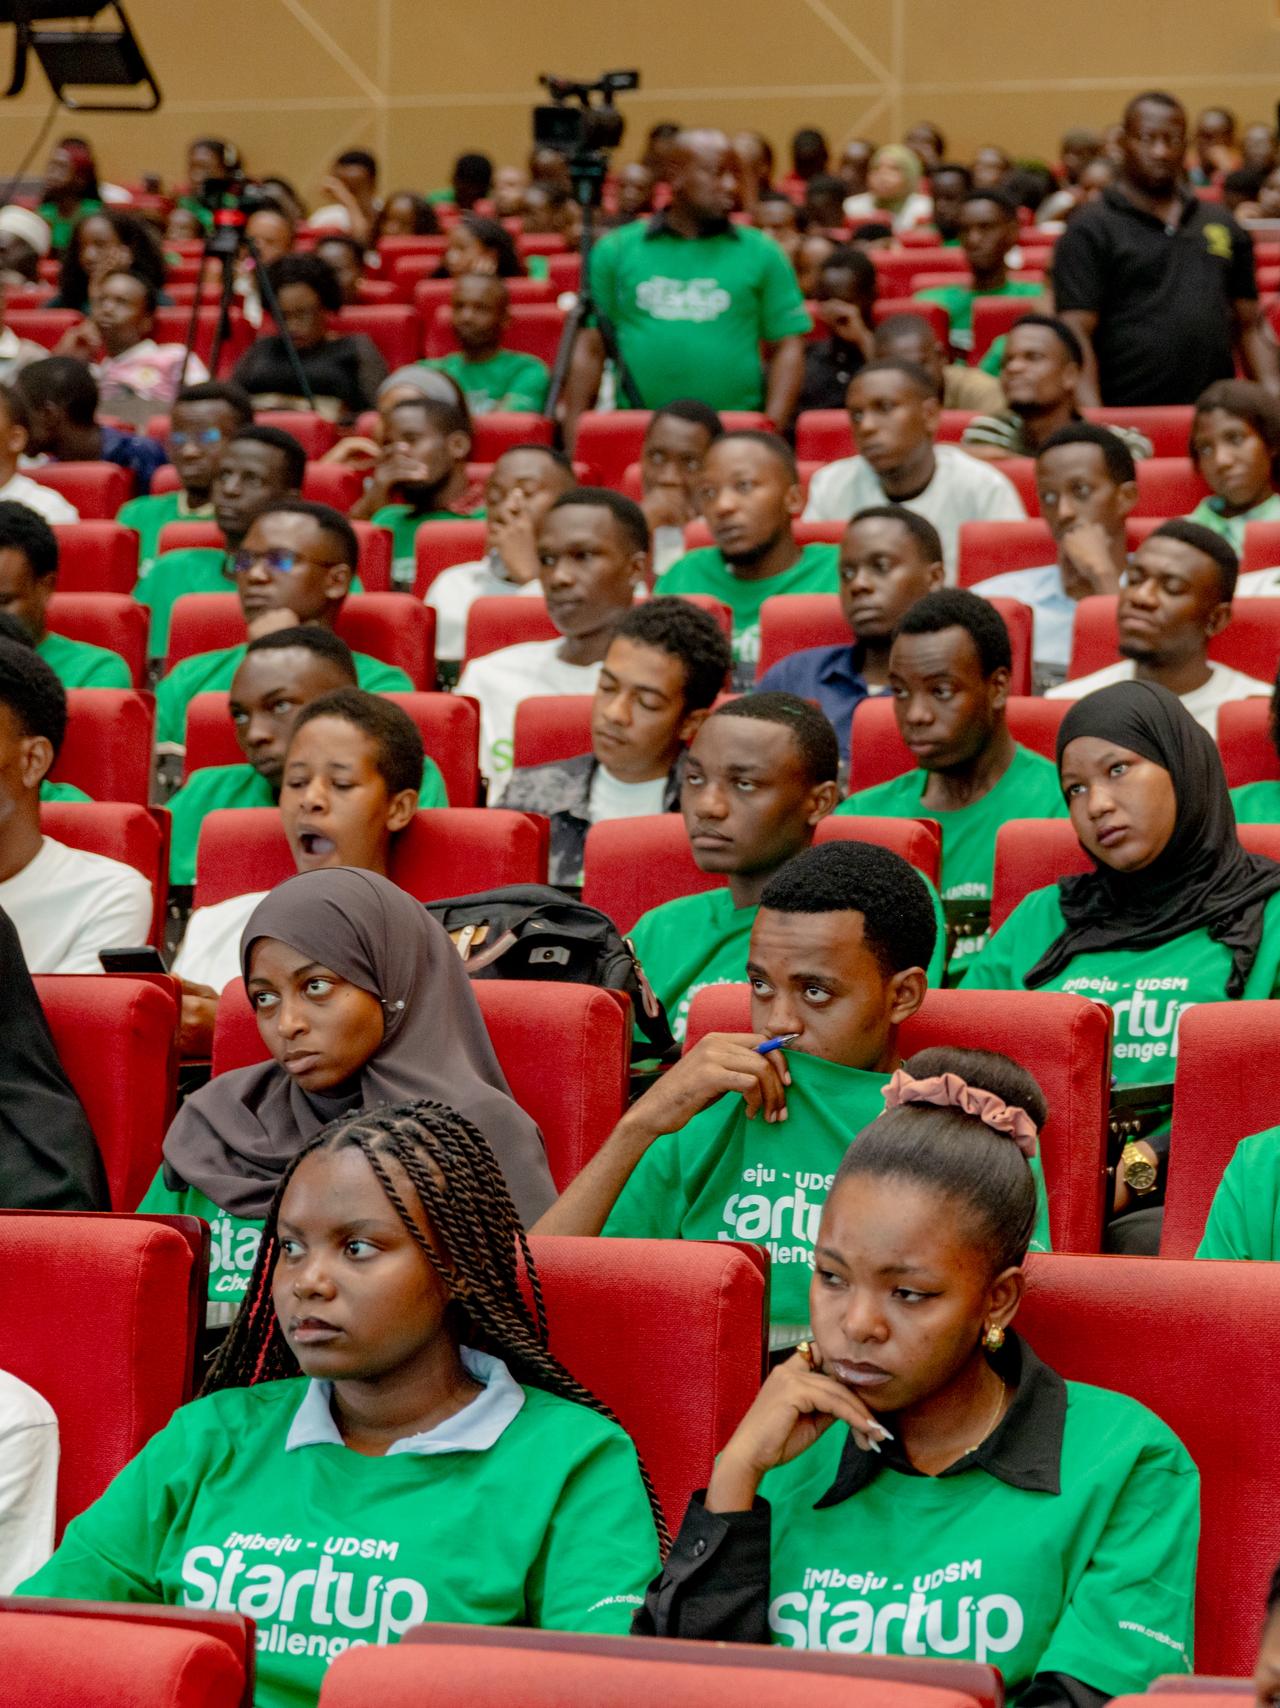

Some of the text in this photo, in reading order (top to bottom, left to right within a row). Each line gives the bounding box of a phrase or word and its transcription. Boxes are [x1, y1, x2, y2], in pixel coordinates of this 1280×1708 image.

[1135, 978, 1188, 991] UDSM
[1113, 1042, 1168, 1063] enge
[743, 1163, 776, 1187] eju
[795, 1171, 836, 1191] UDS
[223, 1532, 302, 1557] iMbeju
[323, 1536, 399, 1561] UDSM
[803, 1567, 887, 1595] iMbeju
[912, 1559, 983, 1593] UDSM
[181, 1545, 428, 1648] Startup
[767, 1590, 1024, 1664] Startup
